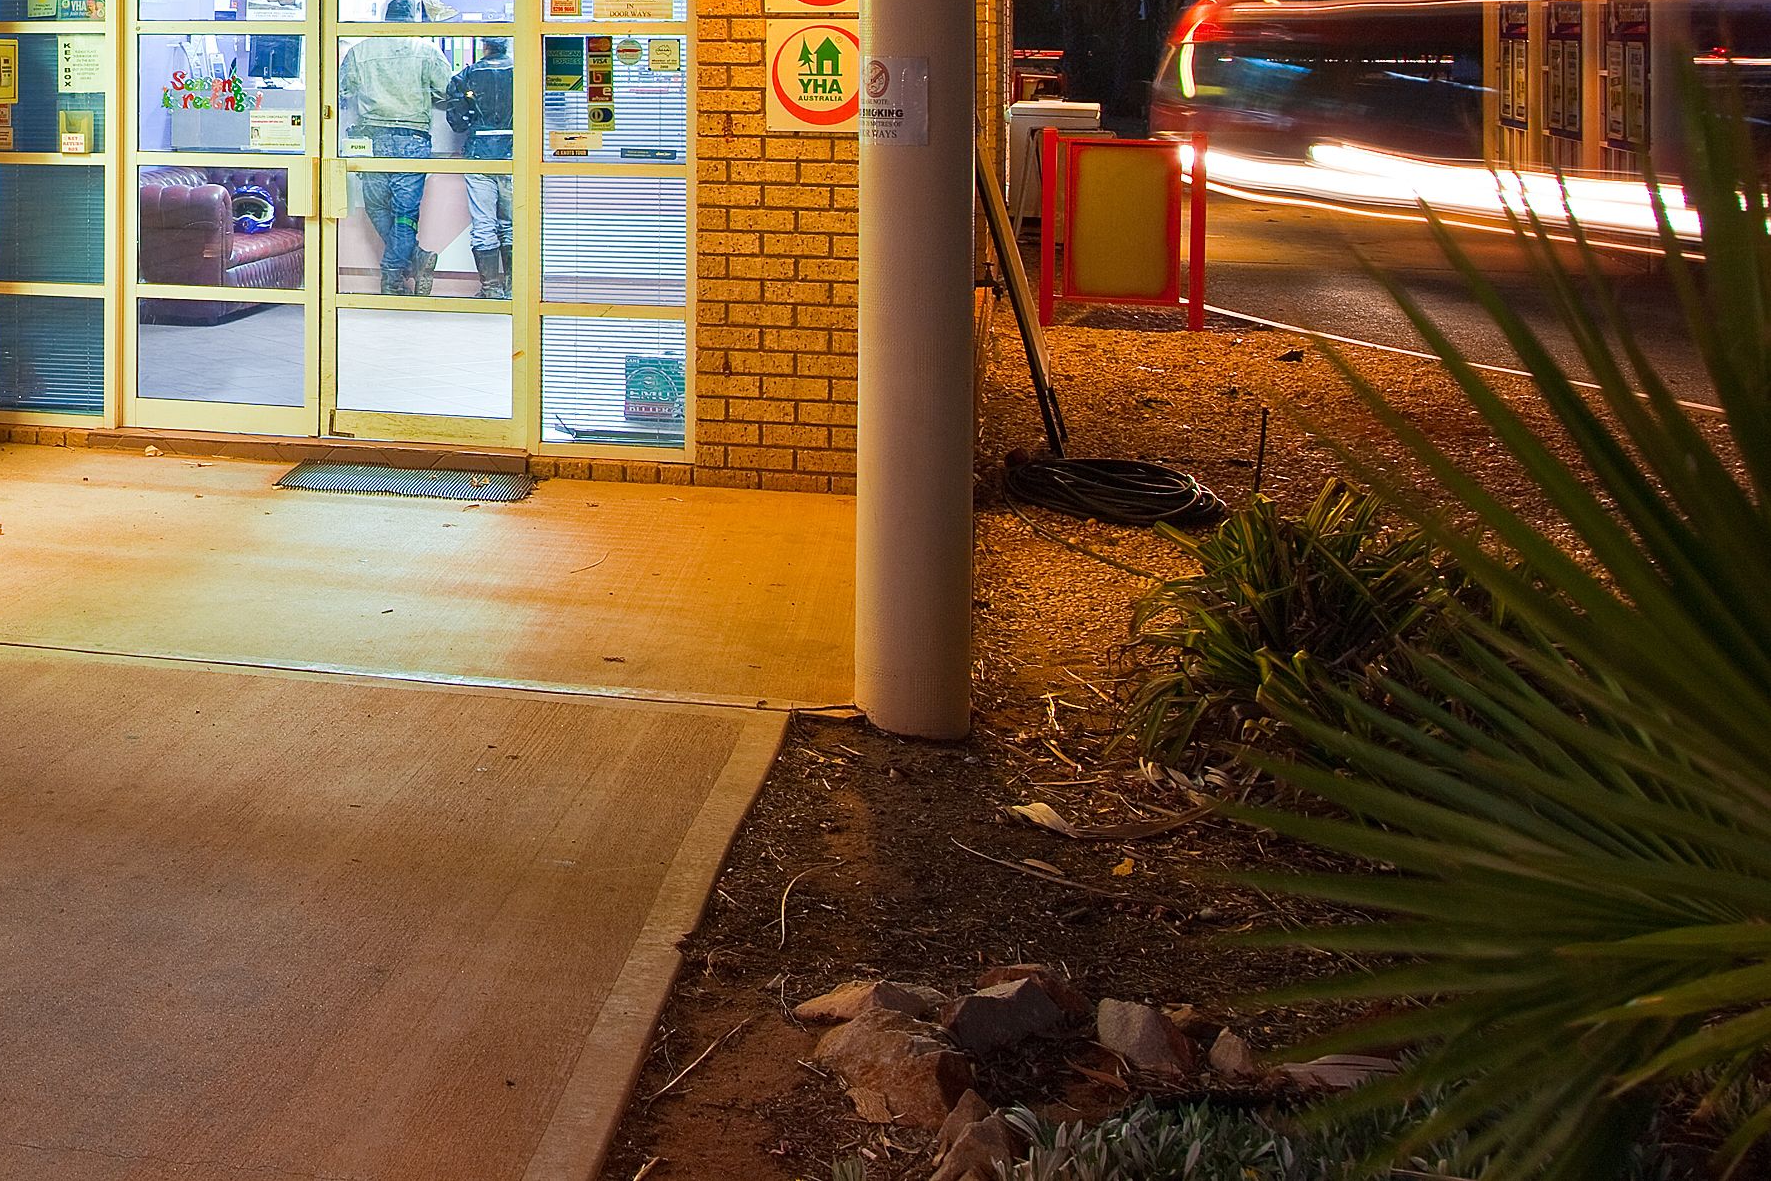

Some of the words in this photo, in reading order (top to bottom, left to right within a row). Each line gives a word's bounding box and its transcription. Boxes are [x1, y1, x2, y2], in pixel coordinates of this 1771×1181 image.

[71, 0, 87, 11] YHA
[63, 43, 71, 62] KEY
[64, 68, 72, 87] BOX
[798, 79, 842, 93] YHA
[872, 130, 897, 138] WAYS
[630, 388, 669, 400] EMU
